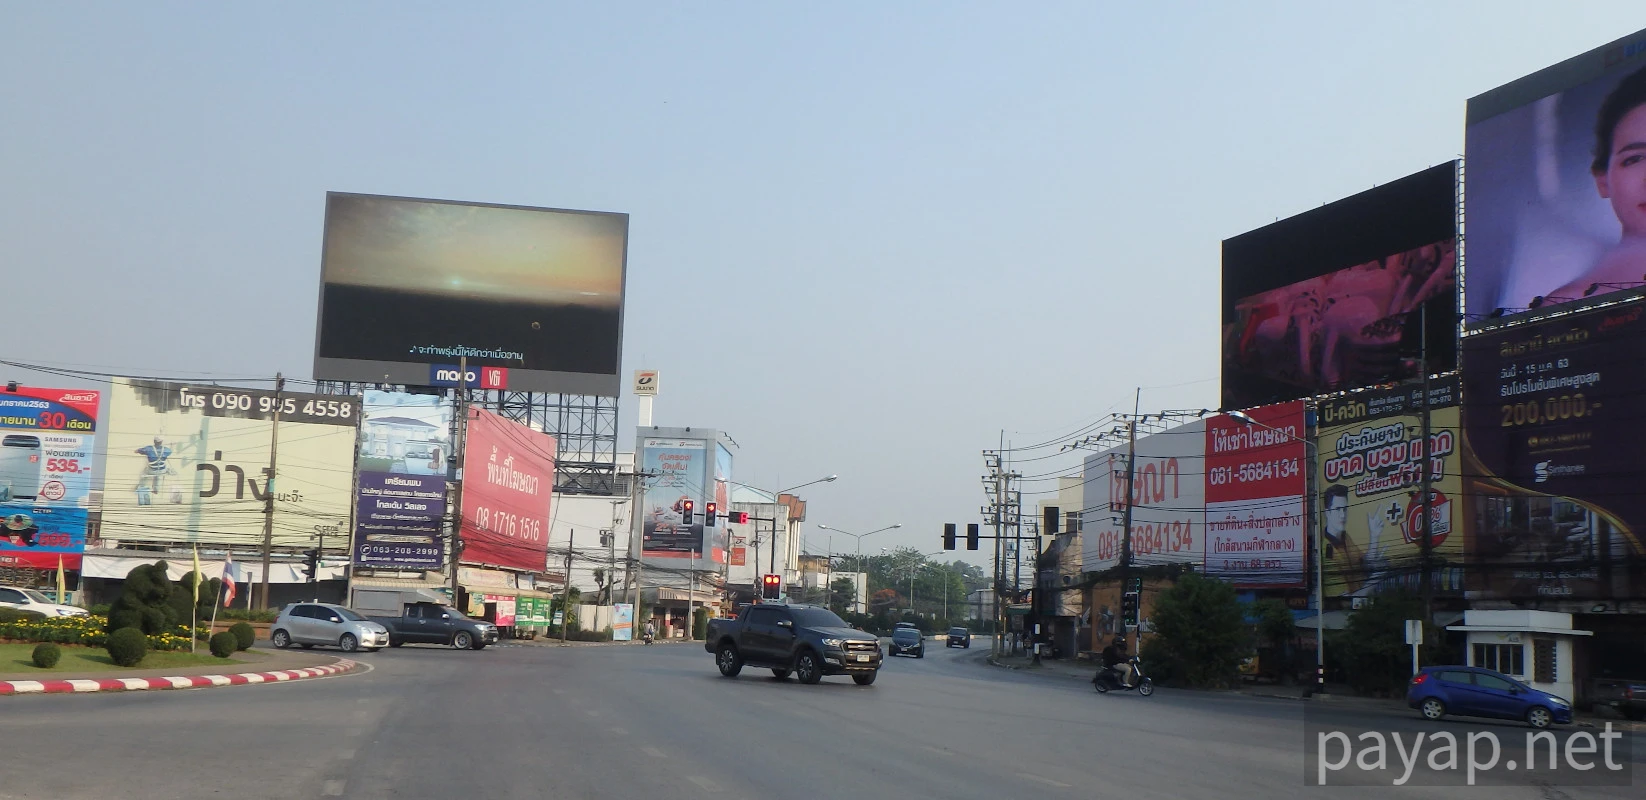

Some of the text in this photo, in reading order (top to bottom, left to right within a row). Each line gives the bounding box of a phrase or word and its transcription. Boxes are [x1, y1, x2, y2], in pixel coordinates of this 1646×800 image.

[436, 369, 476, 382] mao
[1526, 363, 1536, 374] 15
[1557, 358, 1569, 369] 63
[180, 387, 352, 418] โทร 090 995 4558
[1324, 401, 1366, 423] บี-ควิก
[1501, 392, 1603, 427] 200,000.-
[38, 411, 66, 429] 30
[66, 418, 92, 430] เดือน
[1212, 423, 1297, 453] ให้เช่าโฆษณา
[1336, 424, 1403, 451] ประกันยาง
[46, 458, 91, 474] 535.-
[196, 449, 275, 501] ว่าง
[487, 445, 539, 496] พื้นที่โฆษณา
[1210, 457, 1299, 486] 081-5684134
[1326, 454, 1363, 479] บาด
[1367, 444, 1406, 468] บวม
[474, 506, 540, 541] 08 1716 1516
